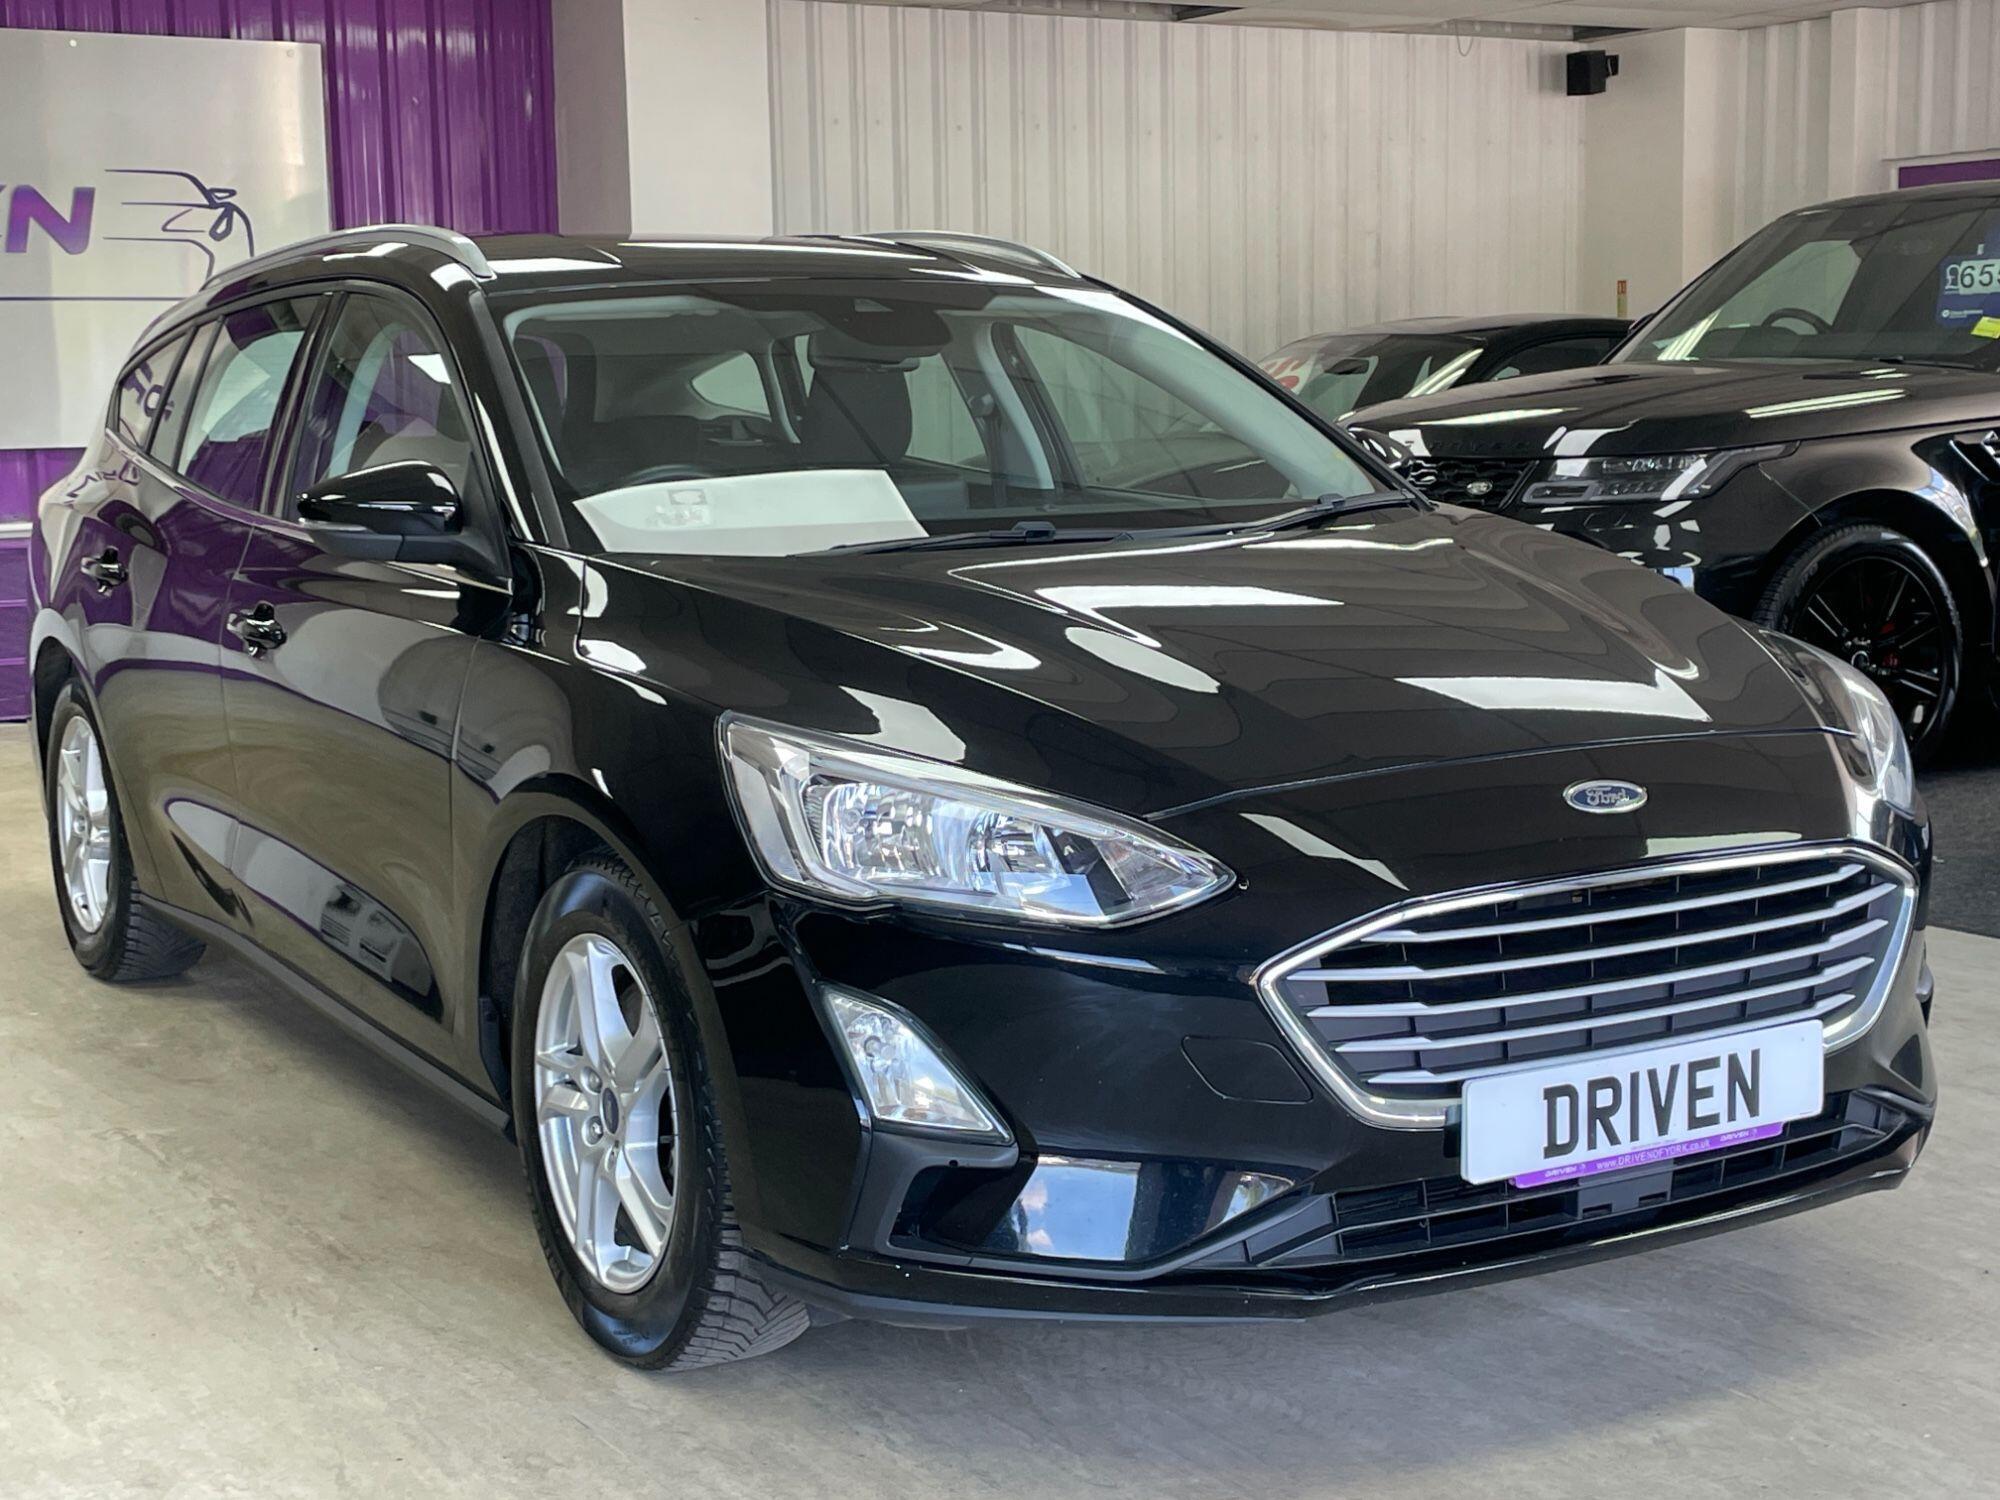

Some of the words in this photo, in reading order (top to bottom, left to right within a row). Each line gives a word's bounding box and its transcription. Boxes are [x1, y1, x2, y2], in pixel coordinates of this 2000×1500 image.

[0, 184, 96, 255] N
[1944, 264, 2000, 289] £65
[1543, 1048, 1761, 1160] DRIVEN
